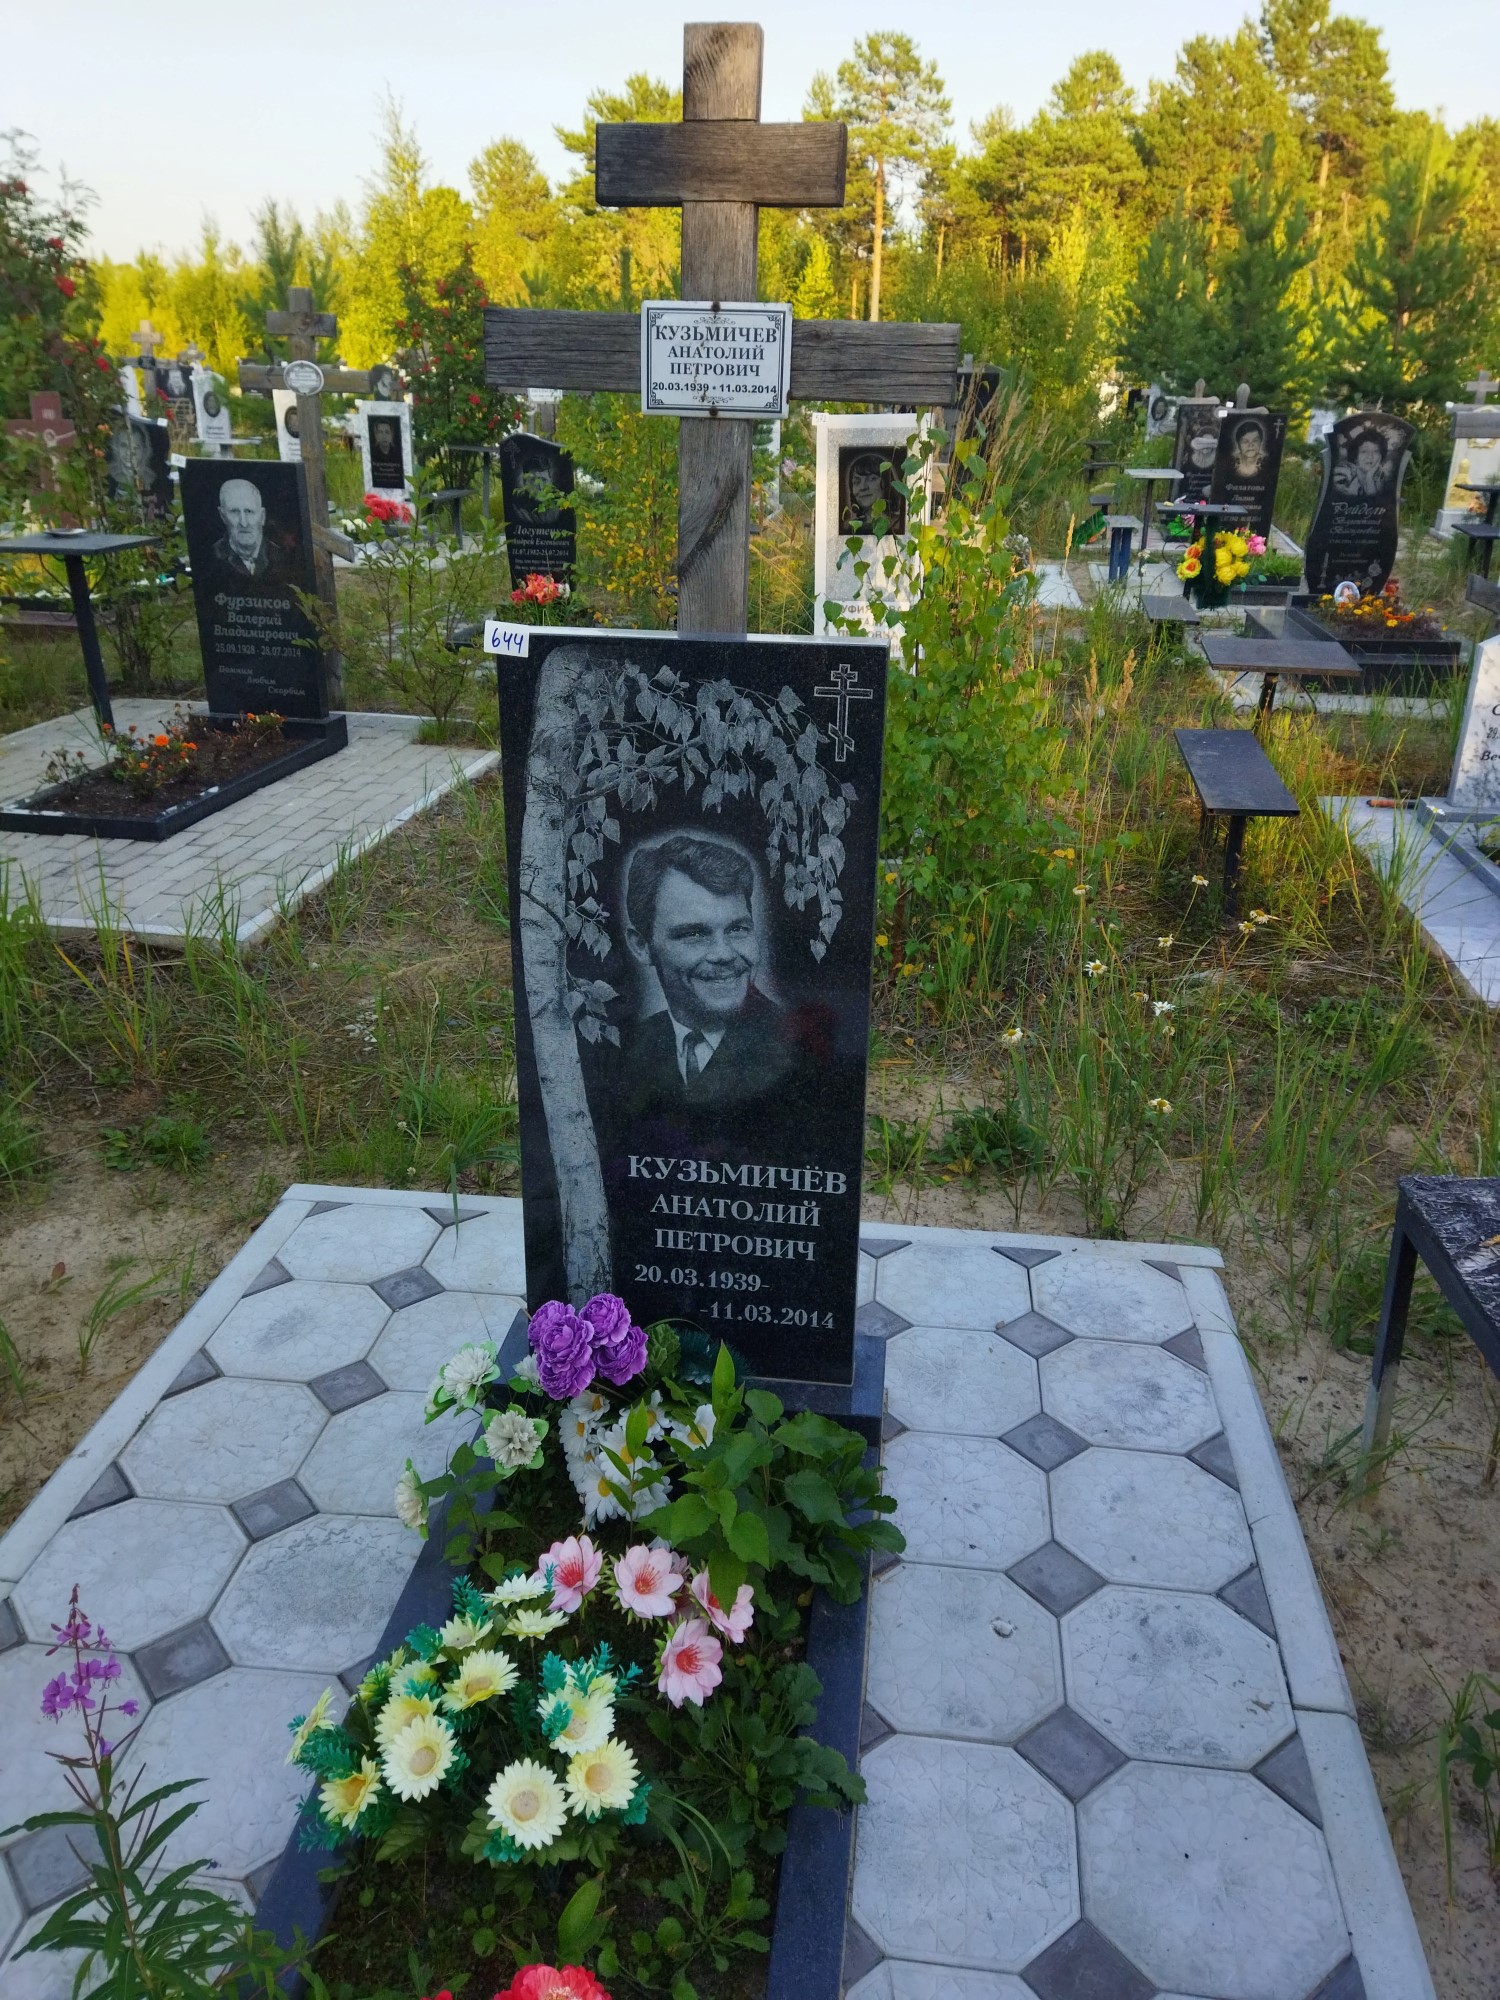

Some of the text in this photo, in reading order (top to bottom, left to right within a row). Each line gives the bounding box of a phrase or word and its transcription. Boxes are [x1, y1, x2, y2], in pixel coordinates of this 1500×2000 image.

[655, 325, 777, 343] КУЗЬМИЧЕВ
[667, 345, 764, 360] АНАТОЛИЙ
[670, 362, 760, 377] ПЕТРОВИЧ
[652, 382, 777, 394] 20.03.1939 11.03.2014
[214, 592, 291, 610] Фурзиков
[227, 611, 282, 628] Валерий
[213, 624, 299, 641] Владимирович
[492, 627, 524, 654] 644
[215, 643, 255, 655] 25.09.1928
[261, 645, 301, 657] 28.07.2014
[627, 1155, 848, 1195] КУЗЬМИЧЁВ
[650, 1193, 821, 1227] АНАТОЛИЙ
[654, 1228, 817, 1262] ПЕТРОВИЧ
[634, 1264, 770, 1292] 20.03.1939-
[699, 1301, 836, 1330] -11.03.2014
